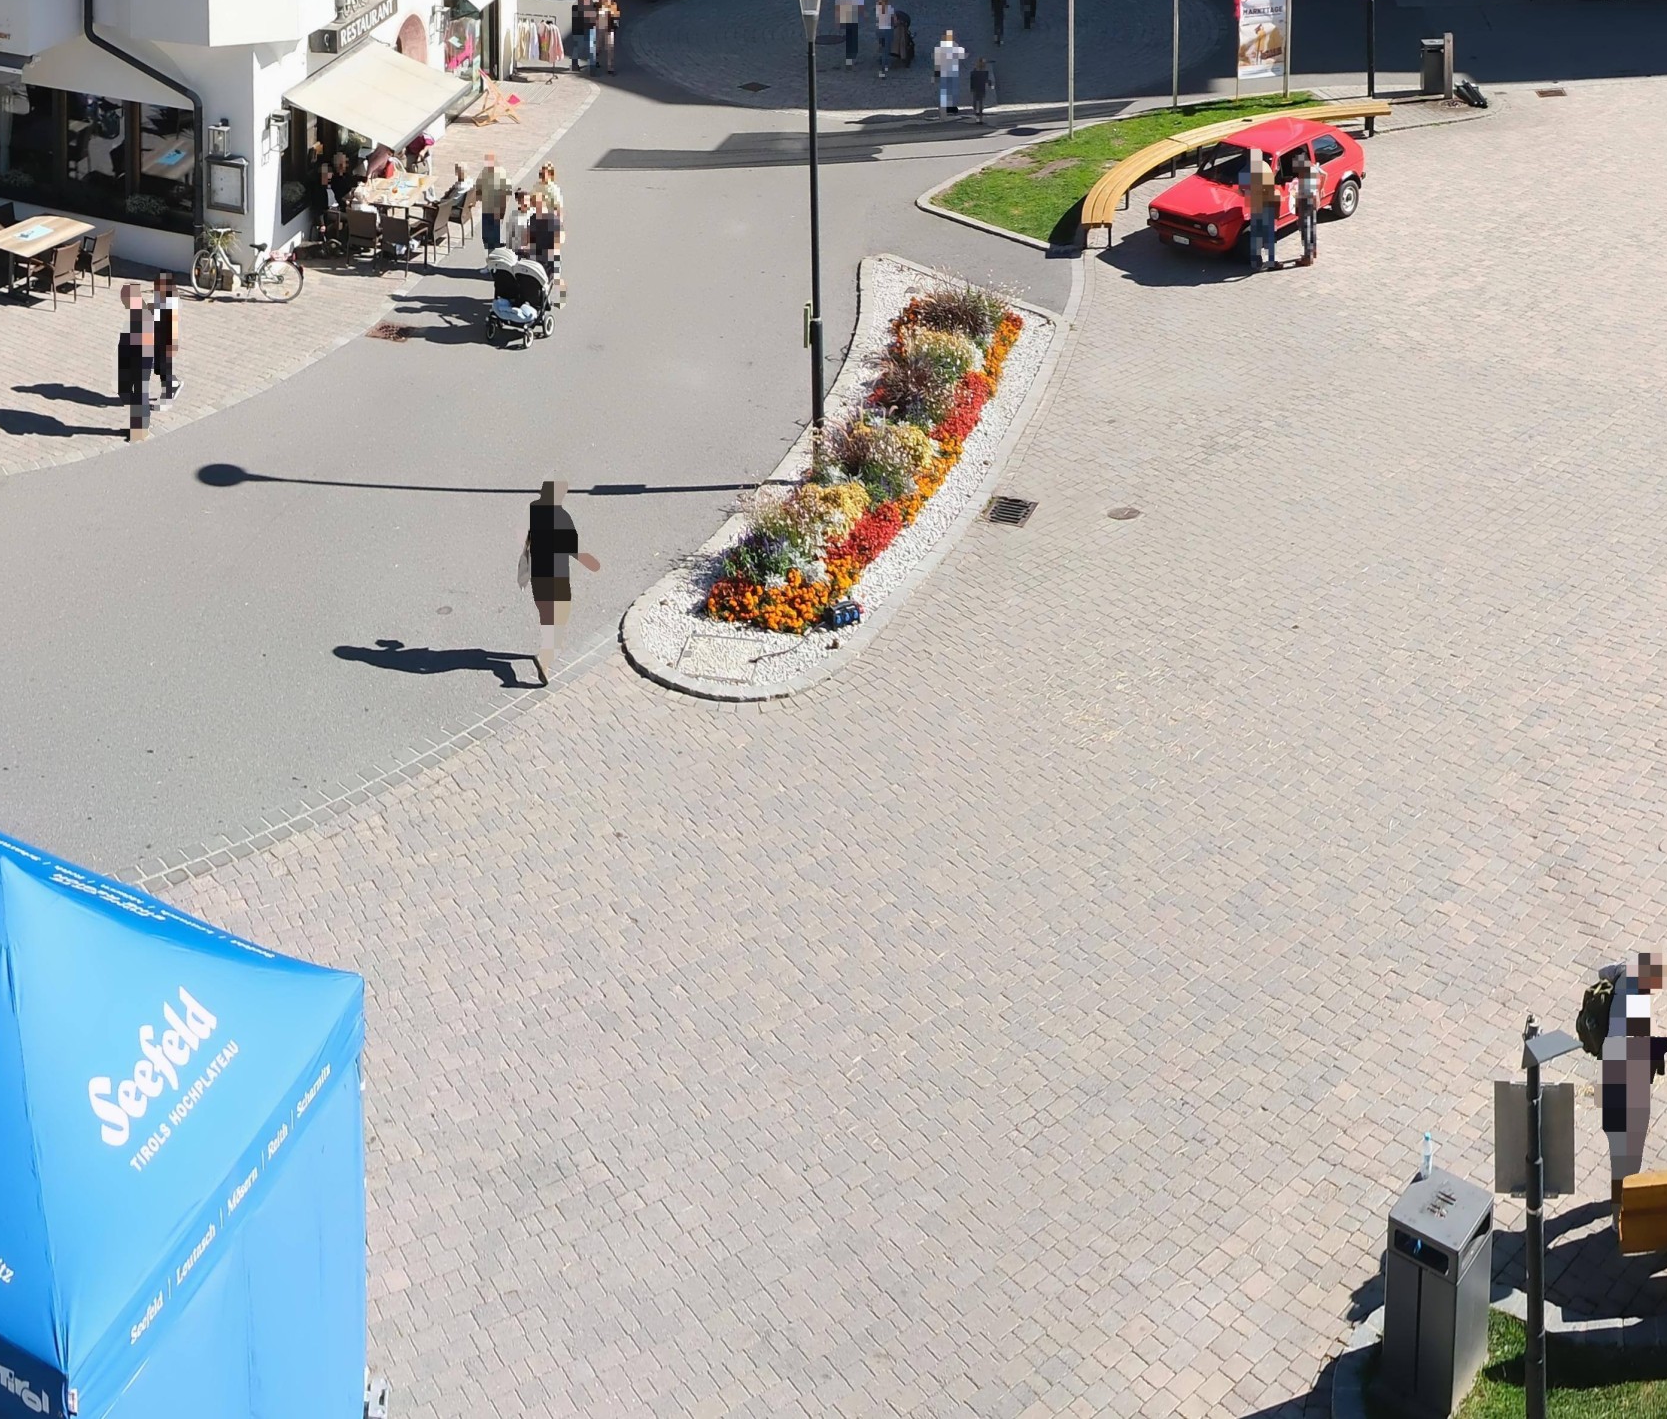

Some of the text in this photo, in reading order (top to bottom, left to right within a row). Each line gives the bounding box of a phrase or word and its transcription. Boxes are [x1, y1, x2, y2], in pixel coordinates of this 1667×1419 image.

[88, 985, 218, 1147] Seefeld
[129, 1039, 239, 1173] TIROLS HOCHPLATEAU
[130, 1062, 332, 1345] Seefeld Leutasch Mösern Reith Scharnitz
